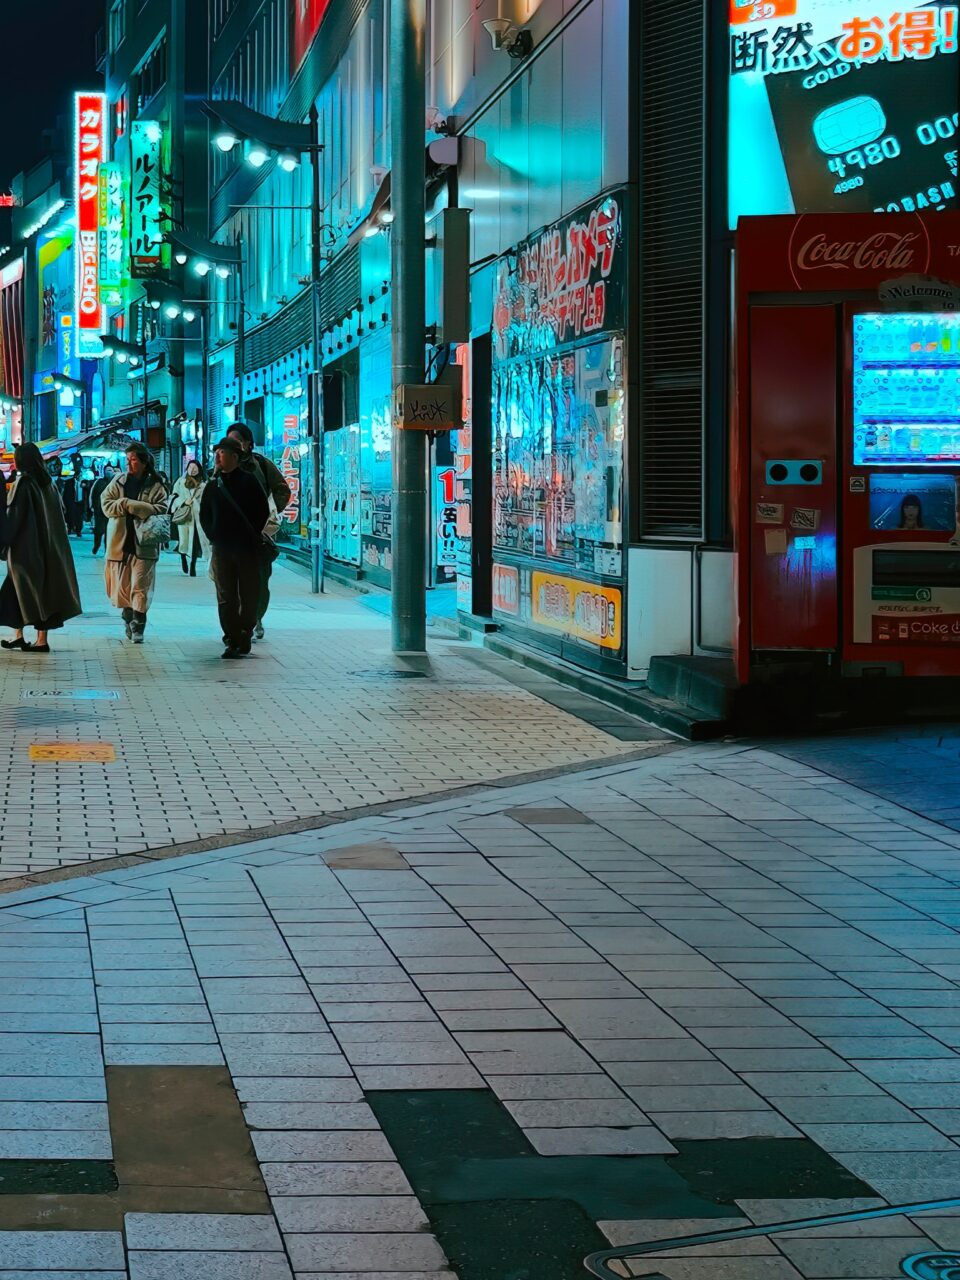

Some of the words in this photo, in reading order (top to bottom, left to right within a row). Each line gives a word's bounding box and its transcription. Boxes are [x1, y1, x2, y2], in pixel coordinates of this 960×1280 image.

[828, 136, 902, 178] 4980
[135, 153, 156, 254] ルノアール
[887, 285, 953, 300] Welcome
[911, 622, 949, 634] Coke
